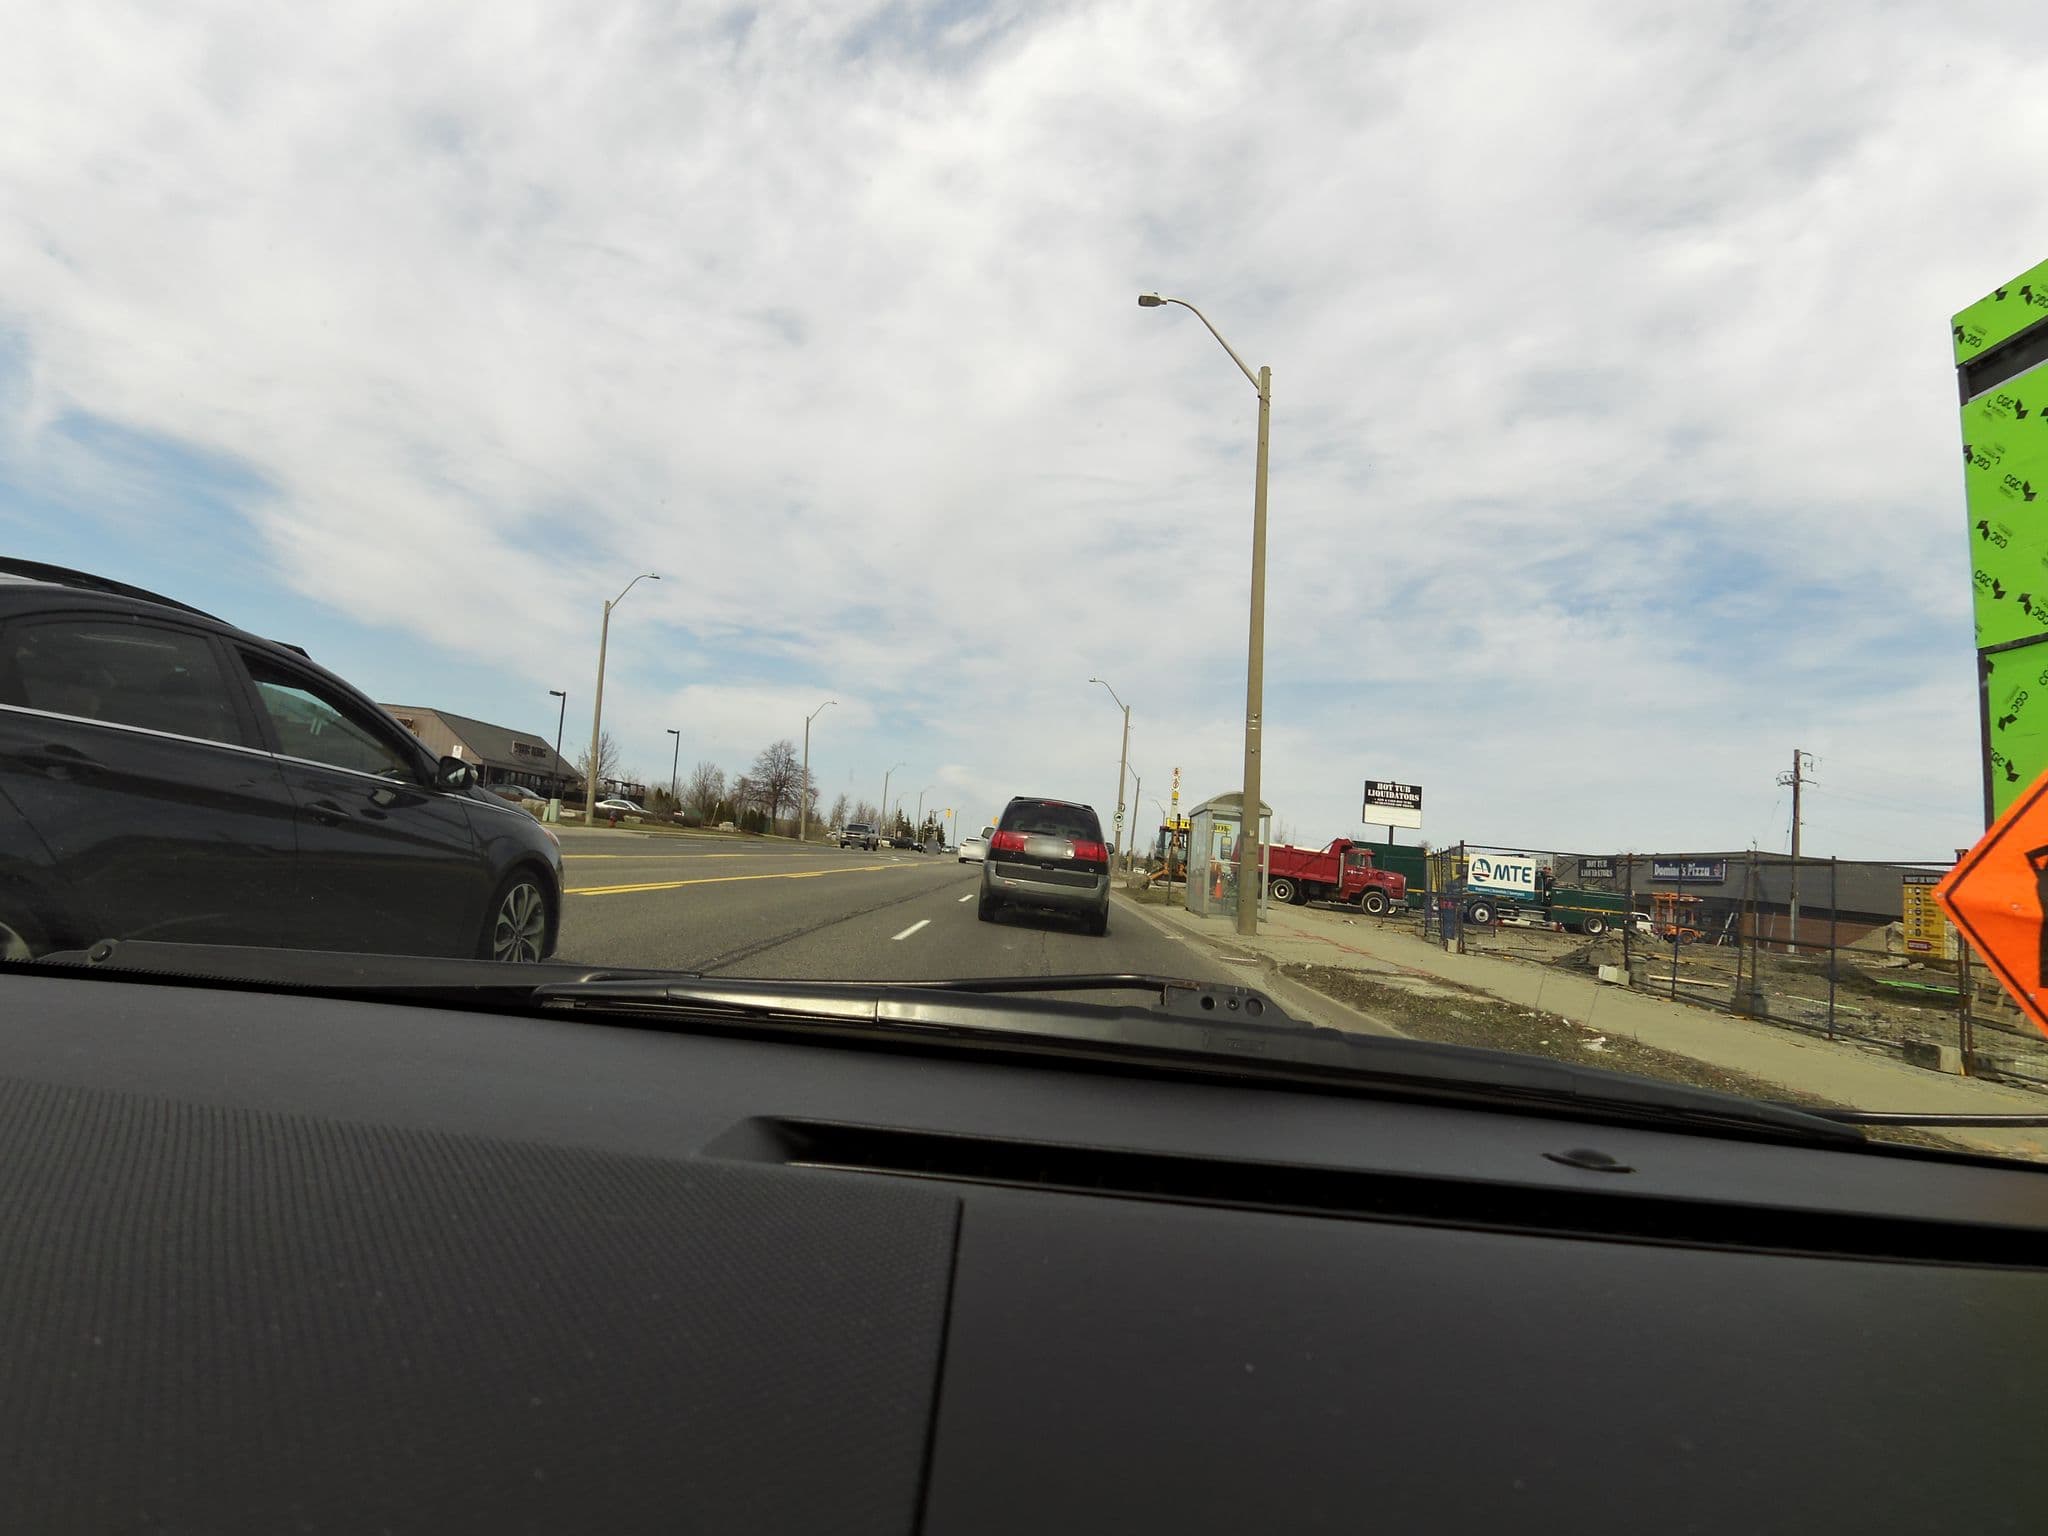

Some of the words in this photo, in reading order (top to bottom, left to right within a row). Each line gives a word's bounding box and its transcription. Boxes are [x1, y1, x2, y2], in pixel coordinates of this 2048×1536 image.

[1965, 333, 1982, 348] CGC
[1996, 394, 2014, 410] CGC
[1973, 454, 1991, 471] CGC
[2004, 474, 2022, 491] CGC
[1989, 531, 2008, 549] CGC
[1974, 569, 1992, 587] CGC
[2010, 691, 2028, 713] CGC
[1367, 789, 1420, 801] LIQUIDATORS
[1377, 783, 1393, 791] HOT
[1395, 785, 1411, 793] TUB
[1493, 864, 1532, 883] MTE
[1688, 863, 1710, 877] Pizza
